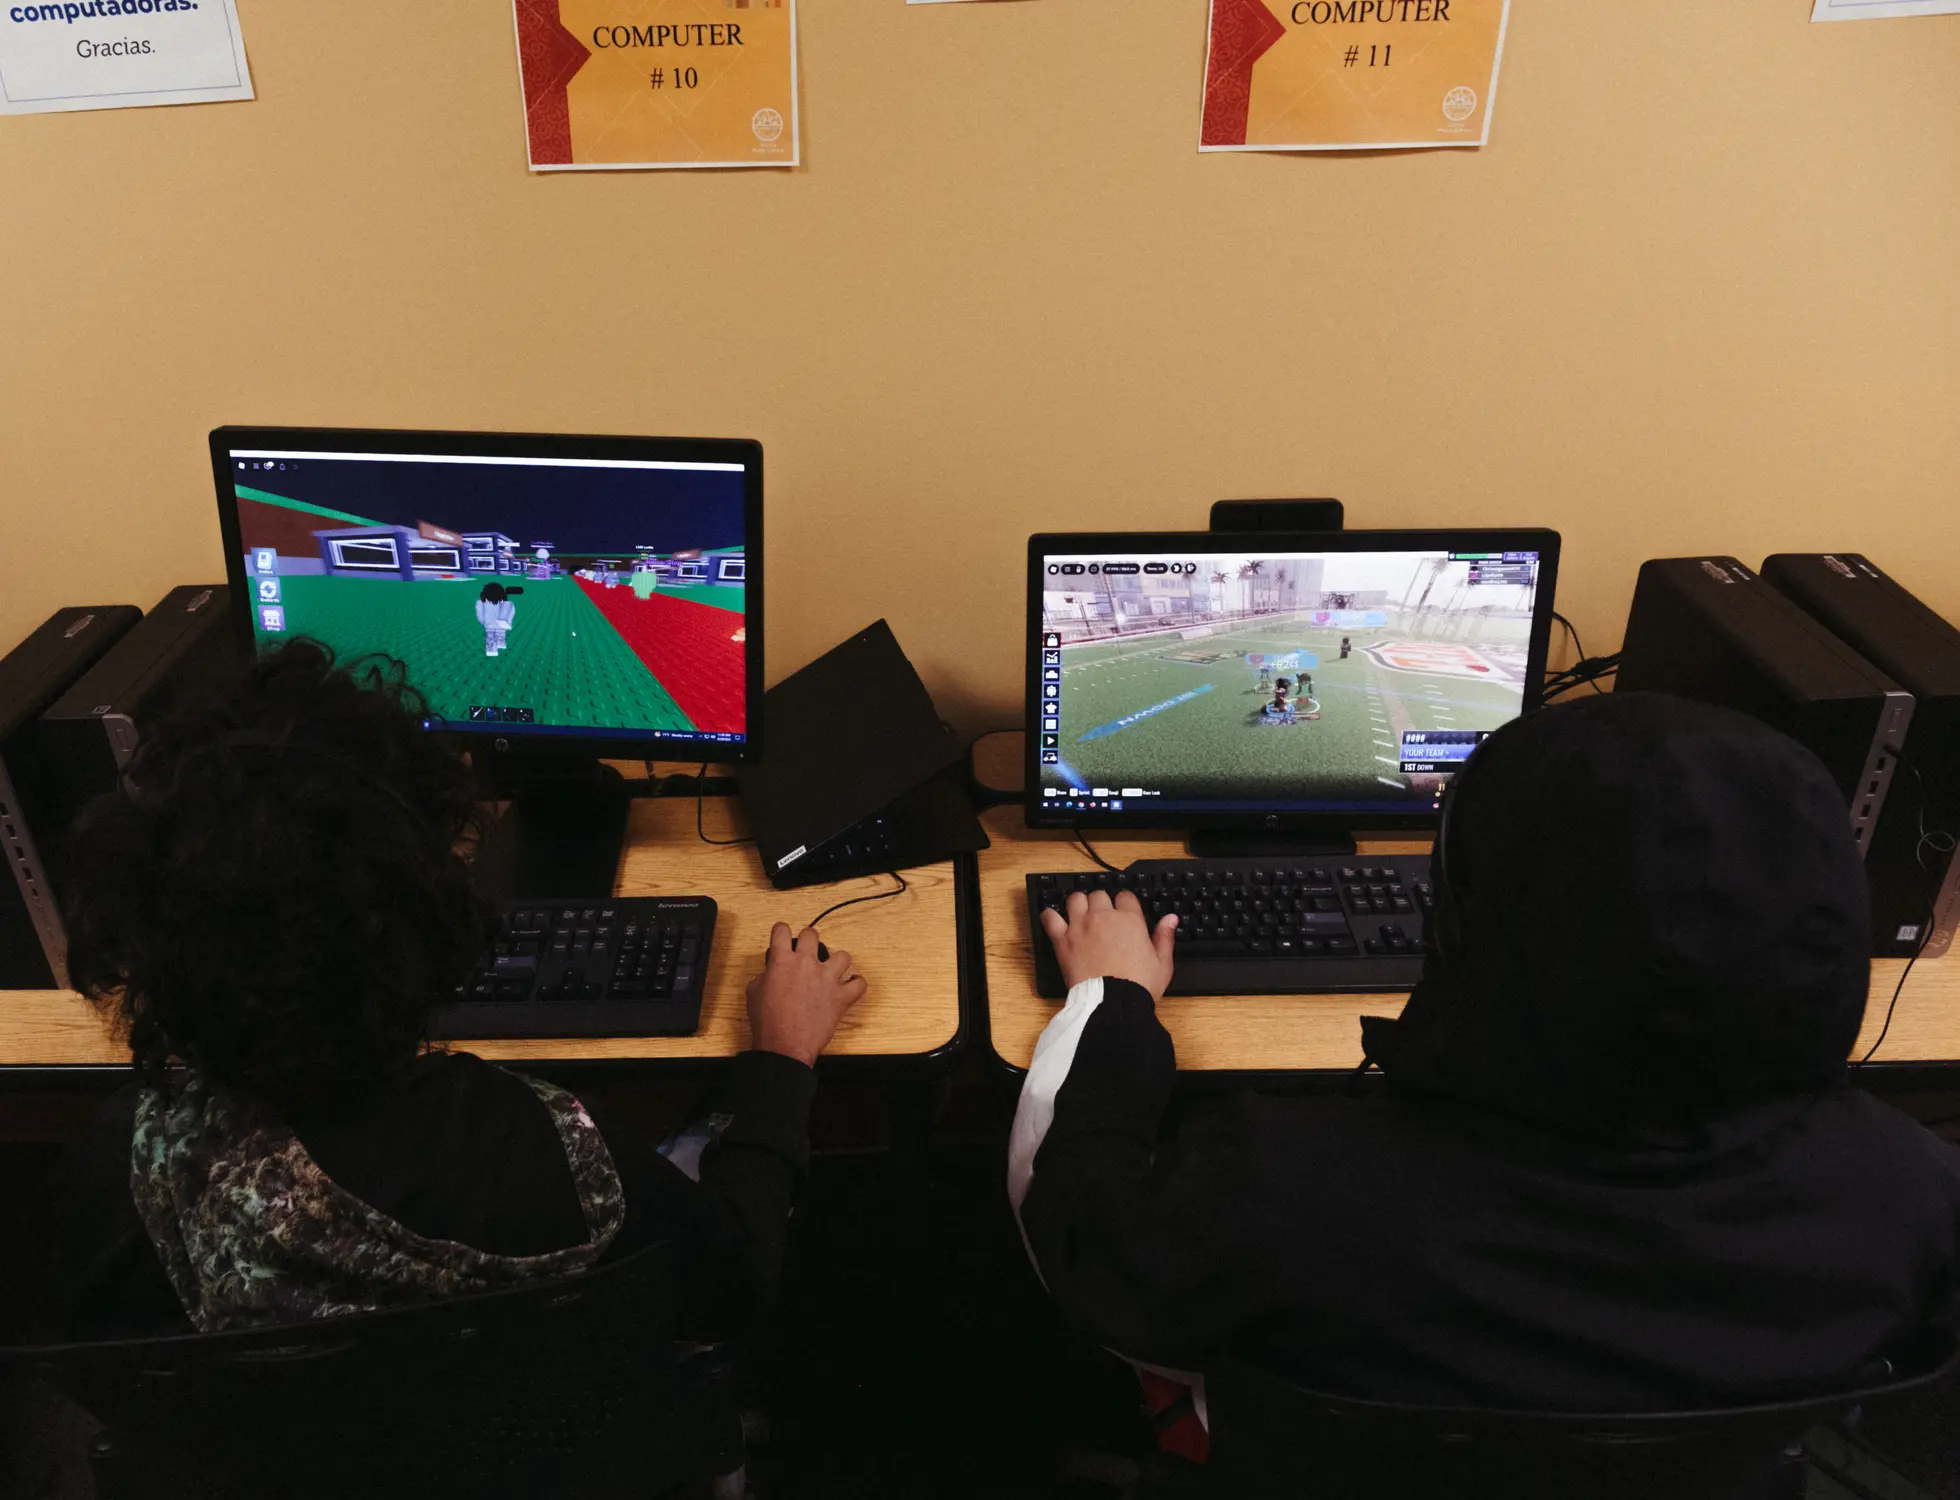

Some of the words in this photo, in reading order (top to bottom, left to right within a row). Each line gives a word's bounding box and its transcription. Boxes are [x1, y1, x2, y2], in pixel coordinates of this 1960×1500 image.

[10, 0, 199, 24] computadoras.
[1290, 0, 1451, 25] COMPUTER
[76, 37, 156, 58] Gracias.
[592, 23, 744, 49] COMPUTER
[1343, 45, 1360, 68] #
[1368, 44, 1392, 67] 11
[650, 68, 665, 90] #
[673, 67, 699, 90] 10
[1403, 748, 1424, 757] YOUR
[1426, 748, 1444, 757] TEAM
[1404, 763, 1417, 771] 1ST
